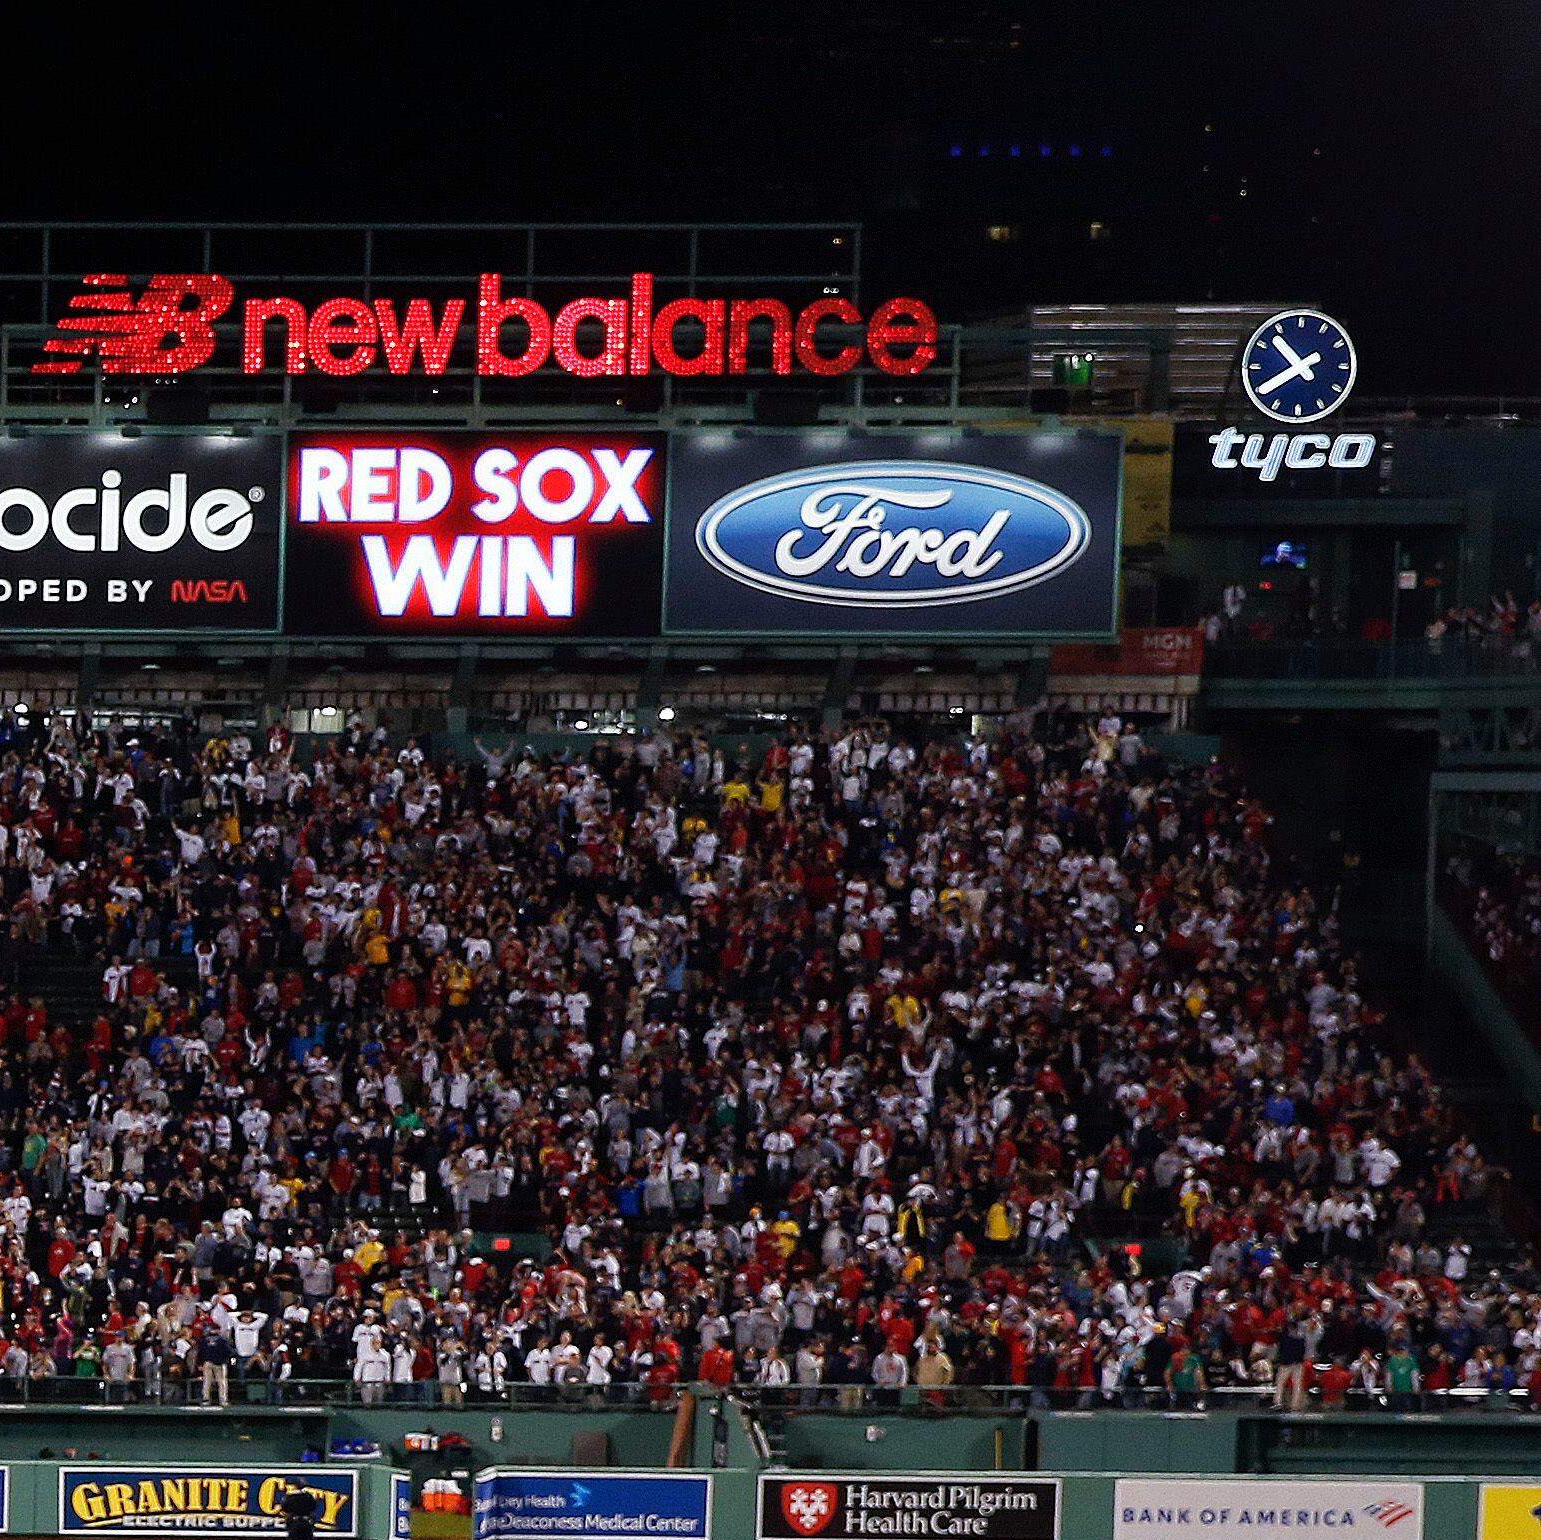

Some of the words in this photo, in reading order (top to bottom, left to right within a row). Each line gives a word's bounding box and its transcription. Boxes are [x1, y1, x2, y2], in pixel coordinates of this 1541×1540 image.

[242, 297, 464, 376] new
[477, 272, 938, 376] balance
[1209, 427, 1377, 482] tyco
[300, 447, 452, 524] RED
[472, 447, 654, 523] SOX
[774, 485, 1012, 579] Ford
[108, 579, 154, 603] BY
[170, 579, 249, 604] NASA
[360, 534, 578, 618] WIN
[1143, 634, 1194, 649] MGM
[72, 1479, 248, 1521] GRANITE
[259, 1477, 348, 1525] CY
[844, 1485, 945, 1510] Harvard
[949, 1486, 1037, 1516] Pilgrim
[122, 1516, 217, 1528] ELECTRIC
[222, 1516, 287, 1529] SUPPL
[585, 1513, 645, 1531] Medical
[645, 1514, 698, 1532] Center
[845, 1510, 928, 1535] Health
[930, 1511, 989, 1535] Care
[1123, 1507, 1190, 1524] BANK
[1200, 1509, 1231, 1524] OF
[1238, 1510, 1355, 1526] AMERICA
